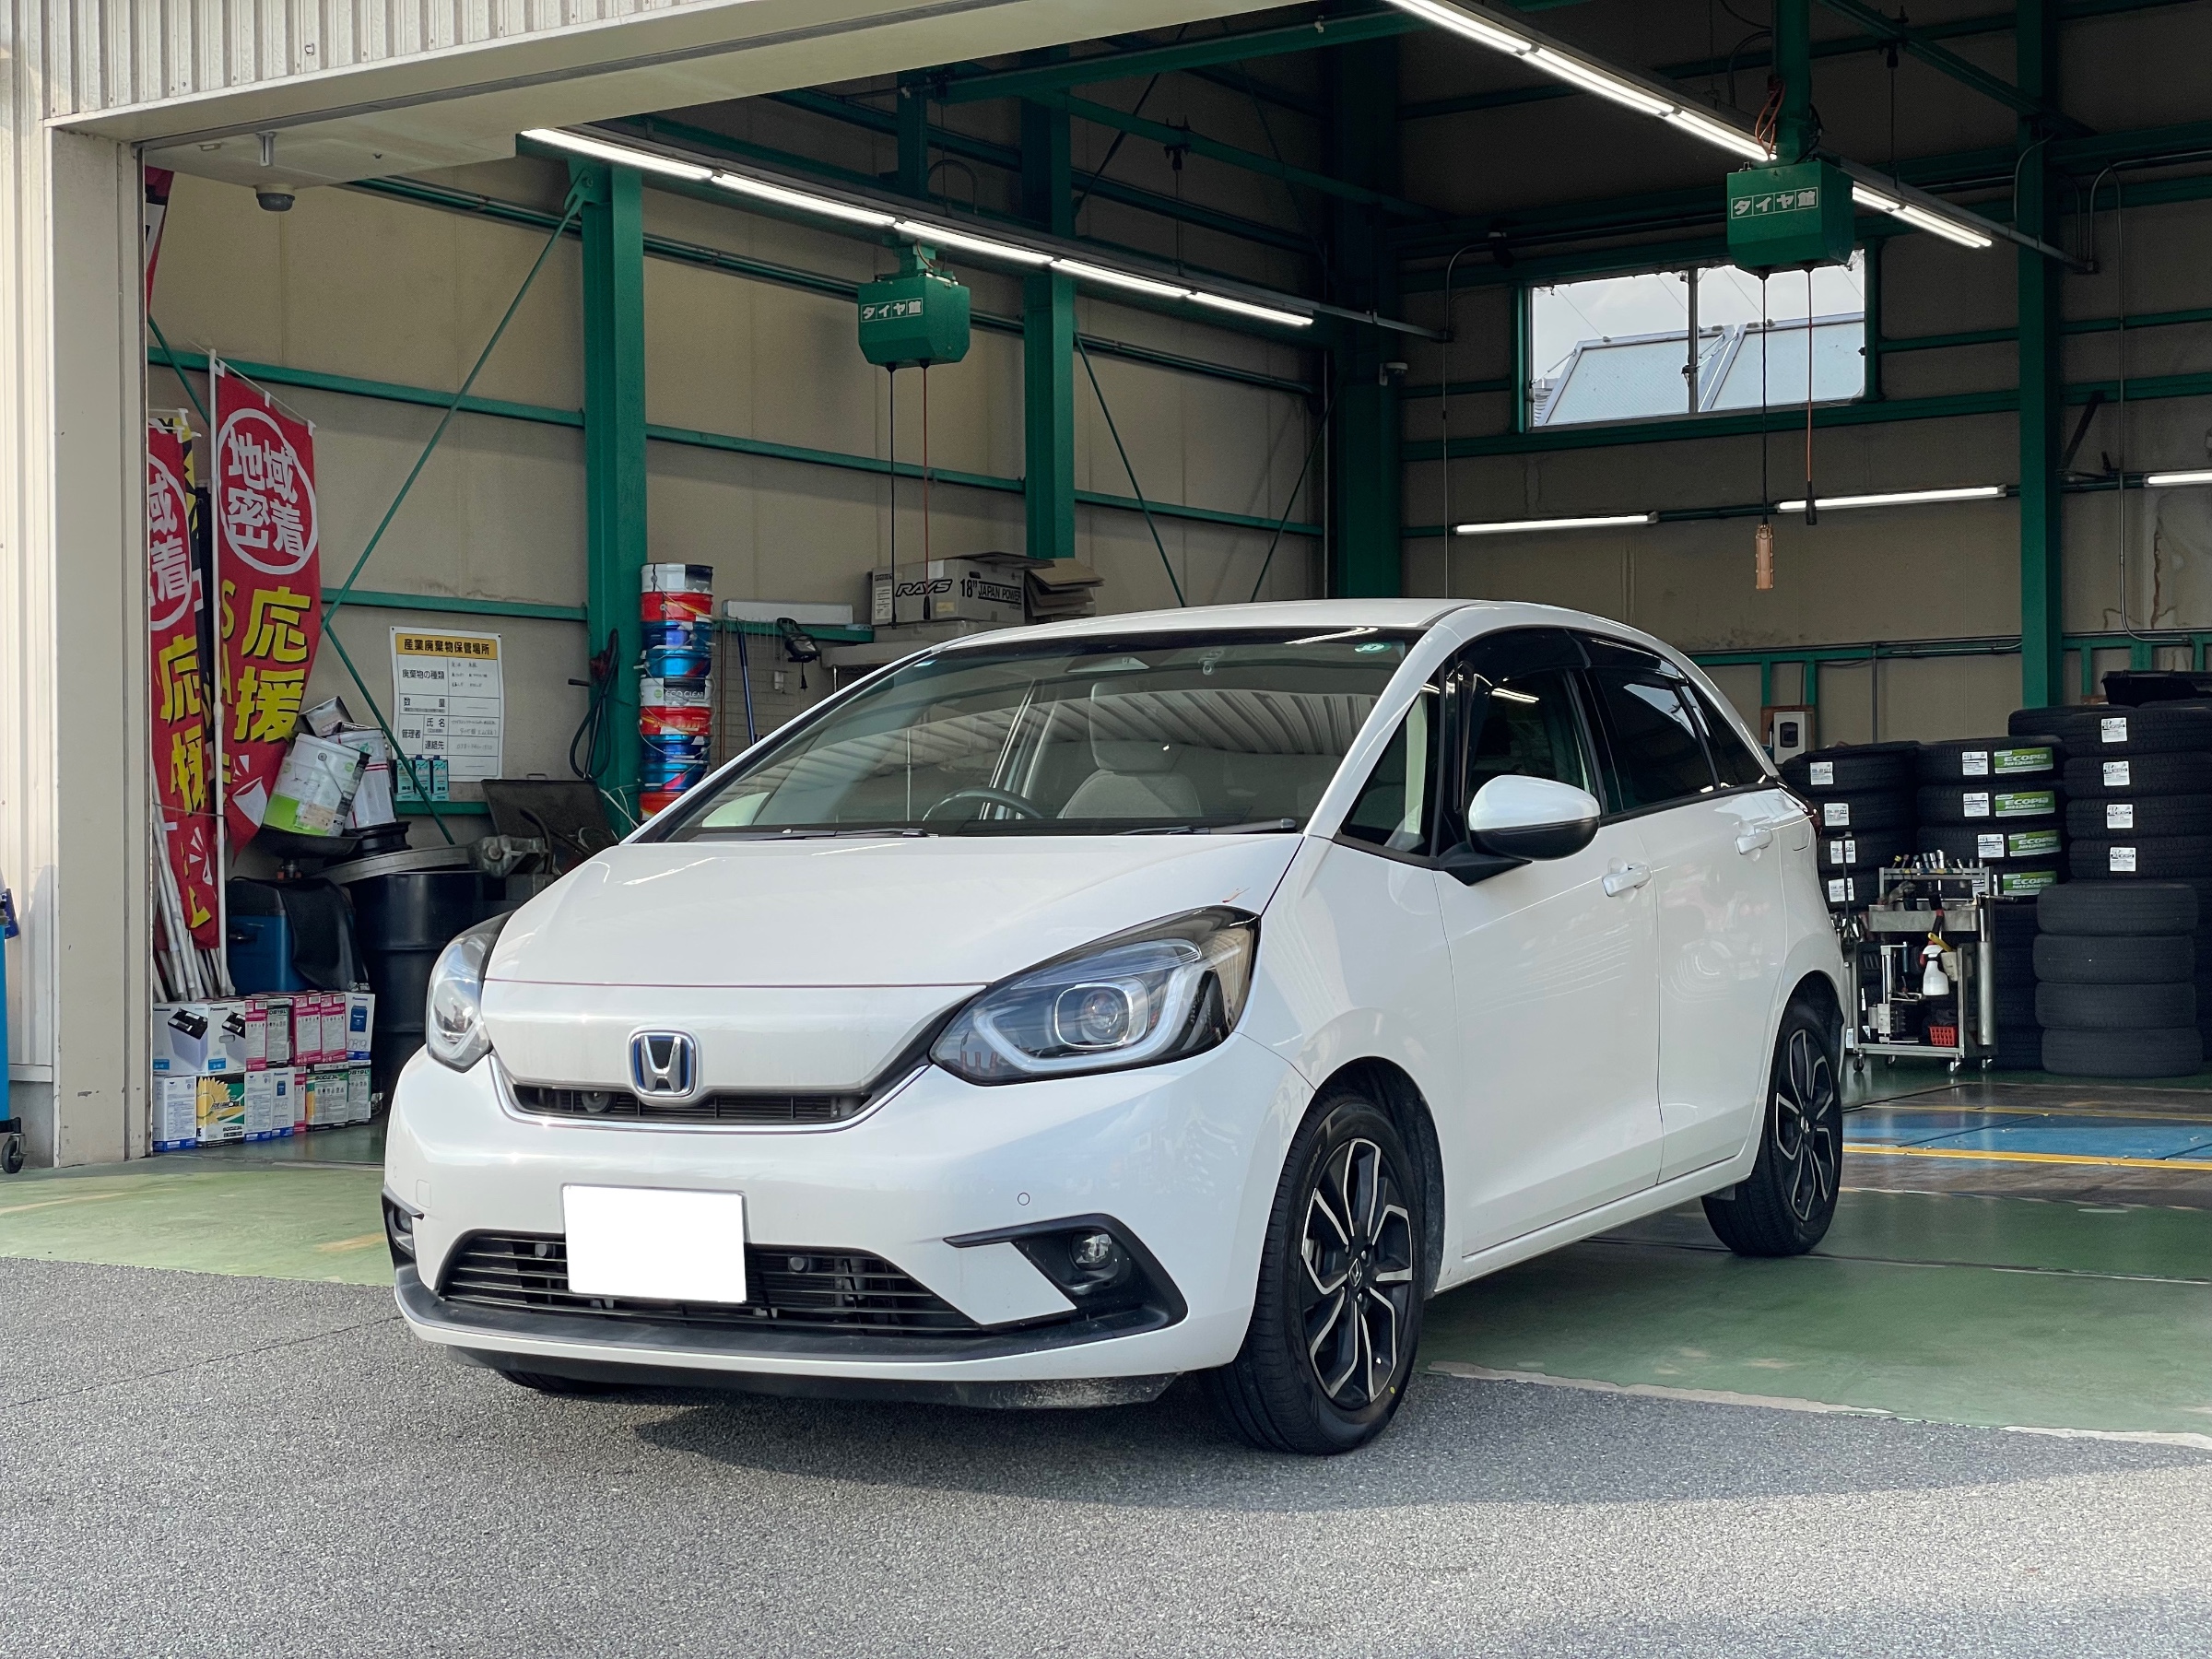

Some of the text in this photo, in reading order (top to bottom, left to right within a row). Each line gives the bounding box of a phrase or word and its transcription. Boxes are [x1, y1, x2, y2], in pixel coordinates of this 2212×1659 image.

[1734, 191, 1816, 216] タイヤ館
[228, 427, 299, 504] 地域
[228, 488, 308, 559] 密着
[895, 579, 953, 598] RAYS
[978, 586, 1001, 599] JAPAN
[1002, 589, 1022, 602] POWER
[404, 638, 490, 655] 産業廃棄物保管場所
[234, 585, 312, 744] 応援
